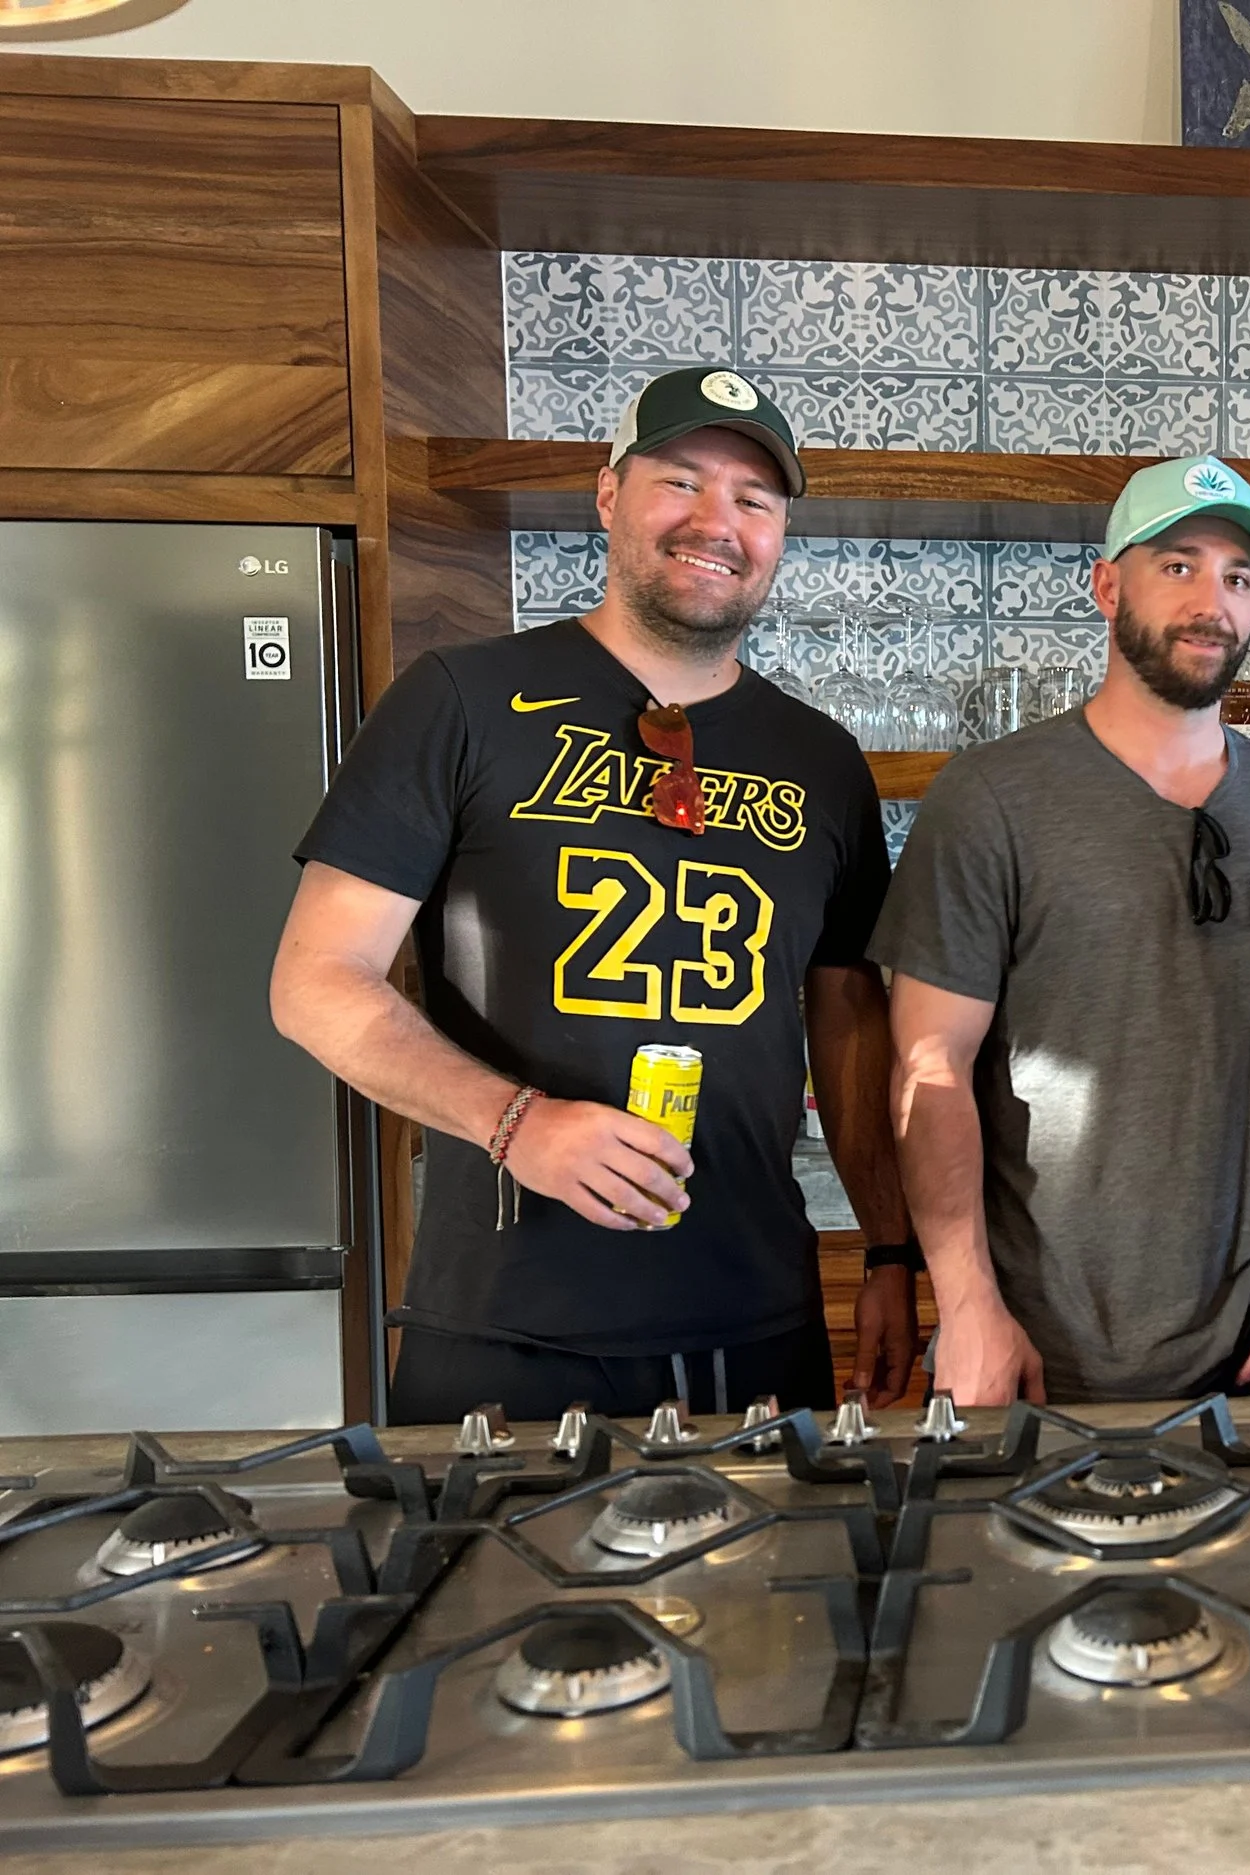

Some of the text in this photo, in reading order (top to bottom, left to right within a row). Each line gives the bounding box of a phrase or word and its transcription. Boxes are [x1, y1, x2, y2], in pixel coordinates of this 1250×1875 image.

[264, 559, 289, 574] LG
[248, 624, 283, 632] LINEAR
[249, 642, 286, 668] 10
[553, 846, 775, 1026] 23
